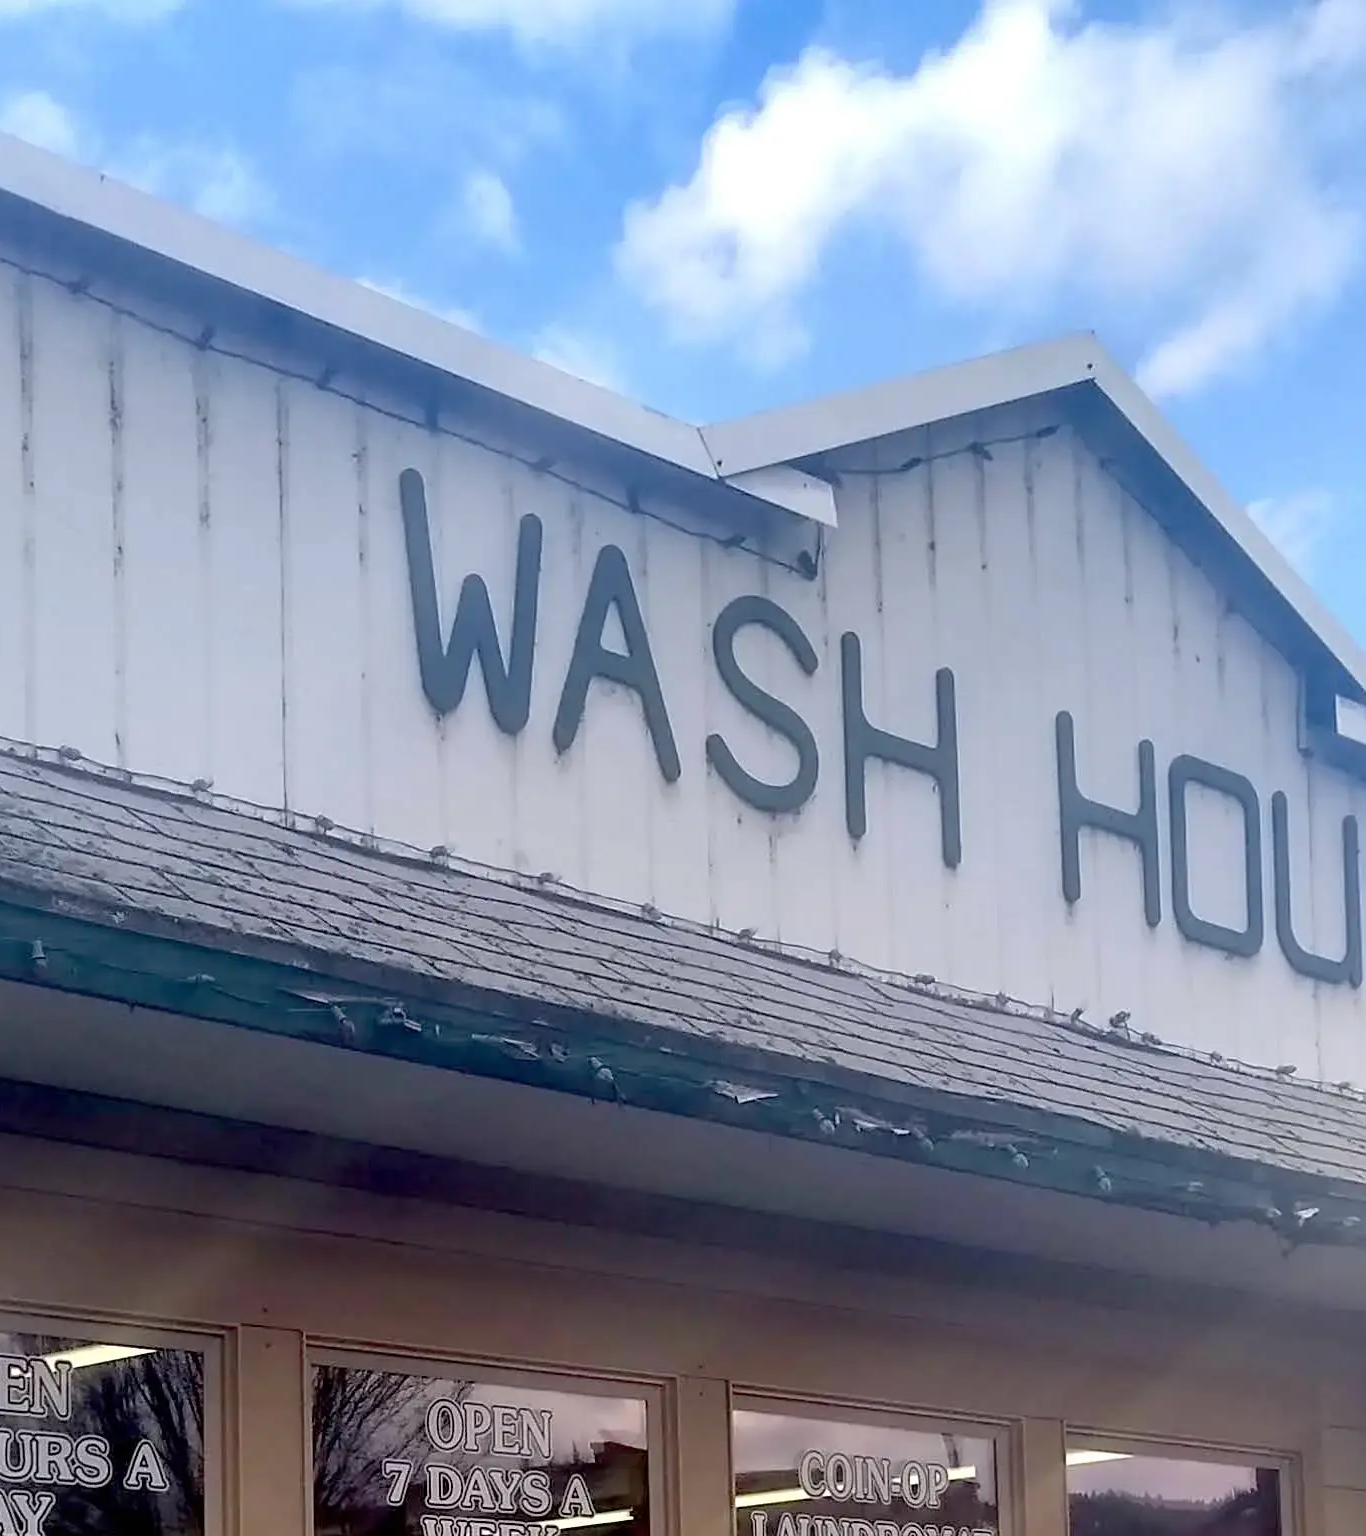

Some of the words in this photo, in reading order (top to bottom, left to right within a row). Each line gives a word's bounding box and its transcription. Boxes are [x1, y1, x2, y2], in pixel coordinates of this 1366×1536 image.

[401, 468, 962, 869] WASH
[426, 1398, 553, 1460] OPEN
[123, 1439, 170, 1492] A
[382, 1459, 412, 1506] 7
[425, 1464, 553, 1516] DAYS
[559, 1474, 595, 1518] A
[799, 1449, 950, 1509] COIN-OP
